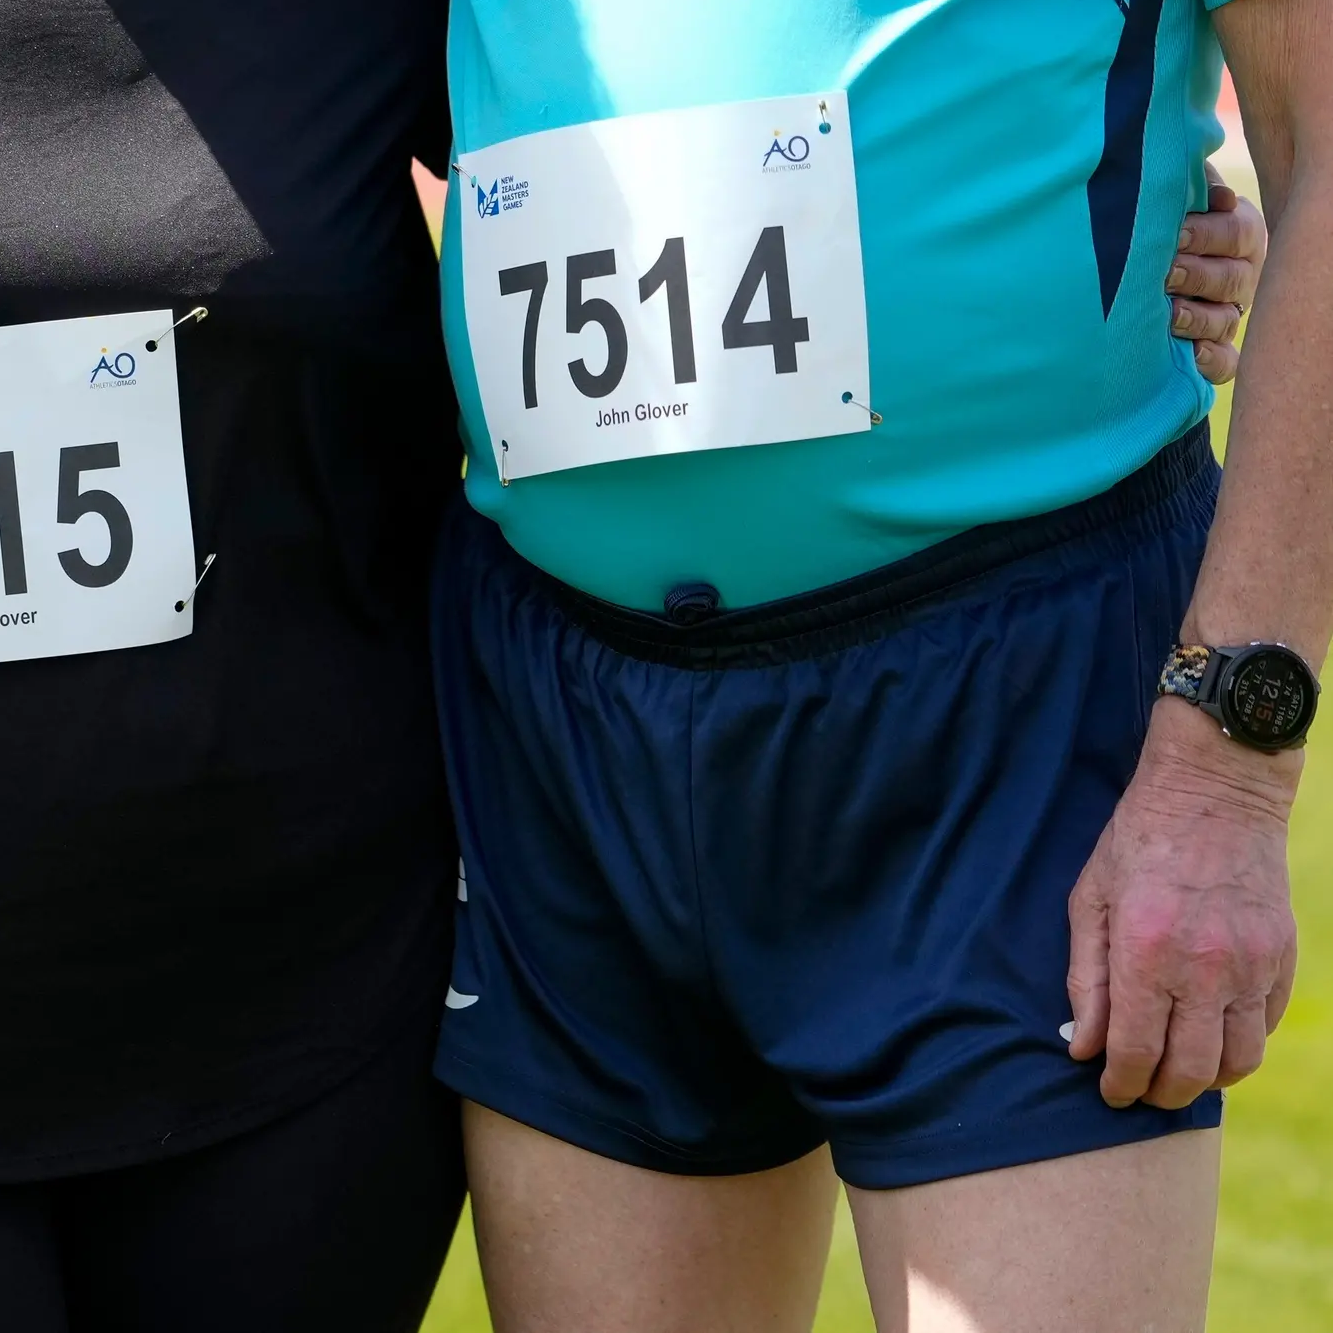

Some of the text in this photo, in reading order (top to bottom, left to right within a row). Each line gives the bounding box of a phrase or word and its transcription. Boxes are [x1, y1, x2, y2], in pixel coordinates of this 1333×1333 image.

[501, 175, 514, 185] NEW
[502, 181, 529, 194] ZEALAND
[502, 190, 529, 202] MASTERS
[503, 200, 523, 211] GAMES
[498, 225, 810, 409] 7514
[596, 402, 688, 427] John Glover
